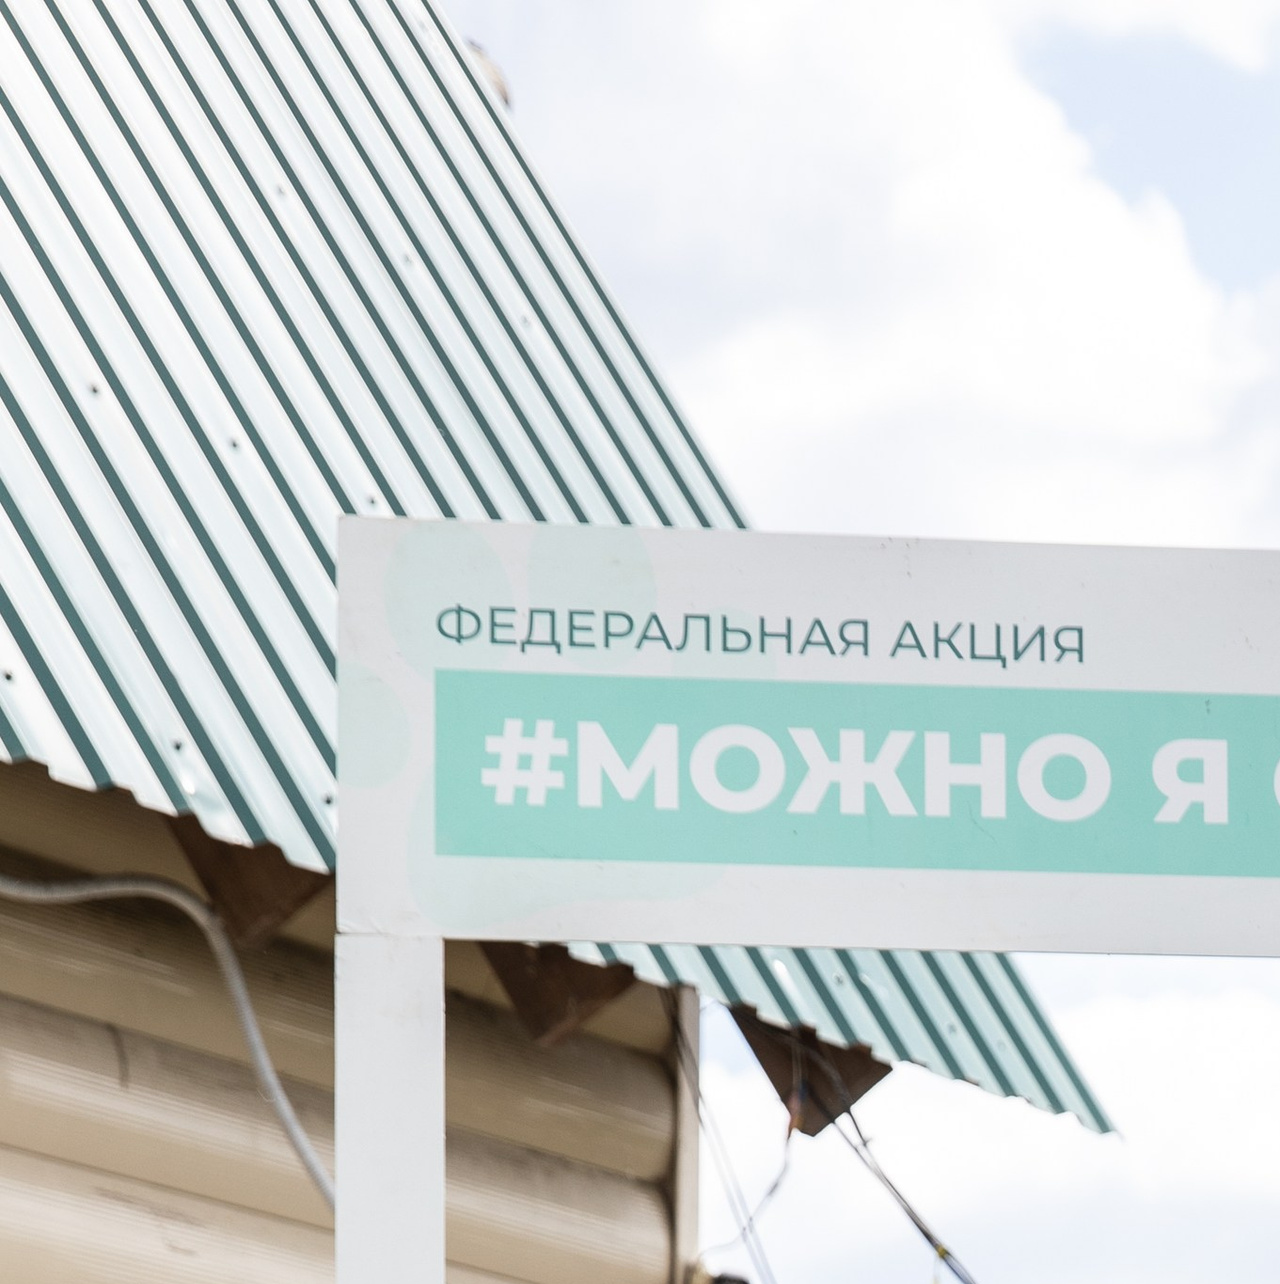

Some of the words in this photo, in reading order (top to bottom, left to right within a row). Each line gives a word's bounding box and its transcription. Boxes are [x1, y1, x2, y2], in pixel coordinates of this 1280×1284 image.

[435, 604, 871, 659] ФЕДЕРАЛЬНАЯ
[890, 620, 1086, 668] АКЦИЯ
[480, 717, 1113, 822] #МОЖНО
[1152, 738, 1229, 825] Я
